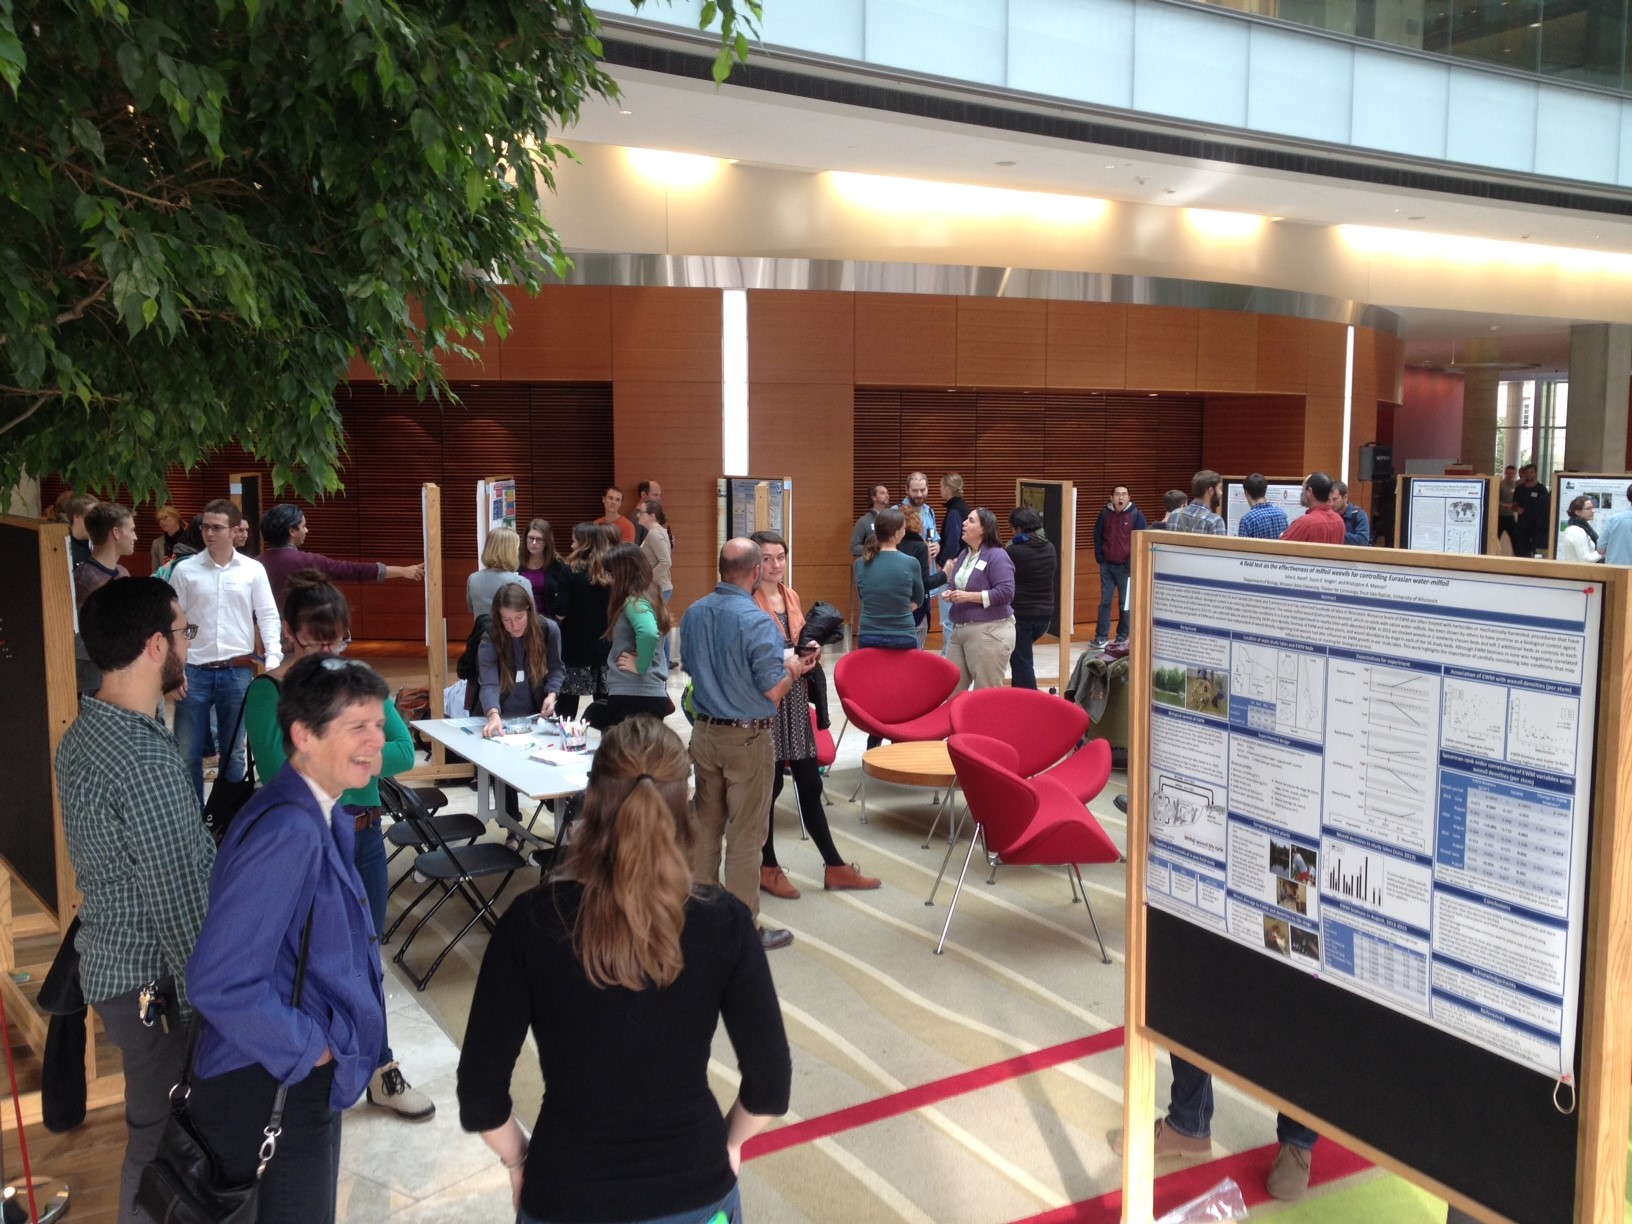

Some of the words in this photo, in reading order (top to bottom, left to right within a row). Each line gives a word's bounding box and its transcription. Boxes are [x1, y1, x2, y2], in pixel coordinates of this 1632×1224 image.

[1278, 564, 1308, 573] effectiveness
[1315, 567, 1330, 575] milfoil
[1331, 569, 1350, 577] weevils
[1359, 571, 1387, 581] controlling
[1388, 574, 1411, 583] Eurasian
[1412, 577, 1449, 587] water-milfoil
[1320, 593, 1336, 601] Abstract
[1392, 593, 1412, 601] University
[1417, 596, 1438, 604] Wisconsin
[1567, 637, 1579, 645] have
[1356, 653, 1380, 662] Expectations
[1387, 658, 1410, 667] experiment
[1450, 667, 1475, 678] Association
[1476, 671, 1481, 679] of
[1482, 672, 1494, 681] EWM
[1495, 675, 1506, 683] with
[1506, 676, 1522, 686] weevil
[1523, 679, 1544, 690] densities
[1545, 683, 1556, 691] (per
[1556, 684, 1572, 694] stem)
[1257, 732, 1279, 742] Experimental
[1442, 751, 1463, 762] Spearman
[1464, 756, 1474, 765] rank
[1474, 758, 1487, 768] order
[1487, 761, 1515, 774] correlations
[1516, 768, 1521, 776] of
[1521, 769, 1535, 779] EWM
[1536, 772, 1558, 784] variables
[1559, 777, 1572, 787] with
[1472, 765, 1487, 775] weevil
[1488, 769, 1508, 780] densities
[1509, 774, 1519, 782] (per
[1520, 776, 1534, 786] stem)
[1483, 897, 1511, 912] Conclusions
[1480, 1006, 1505, 1022] References
